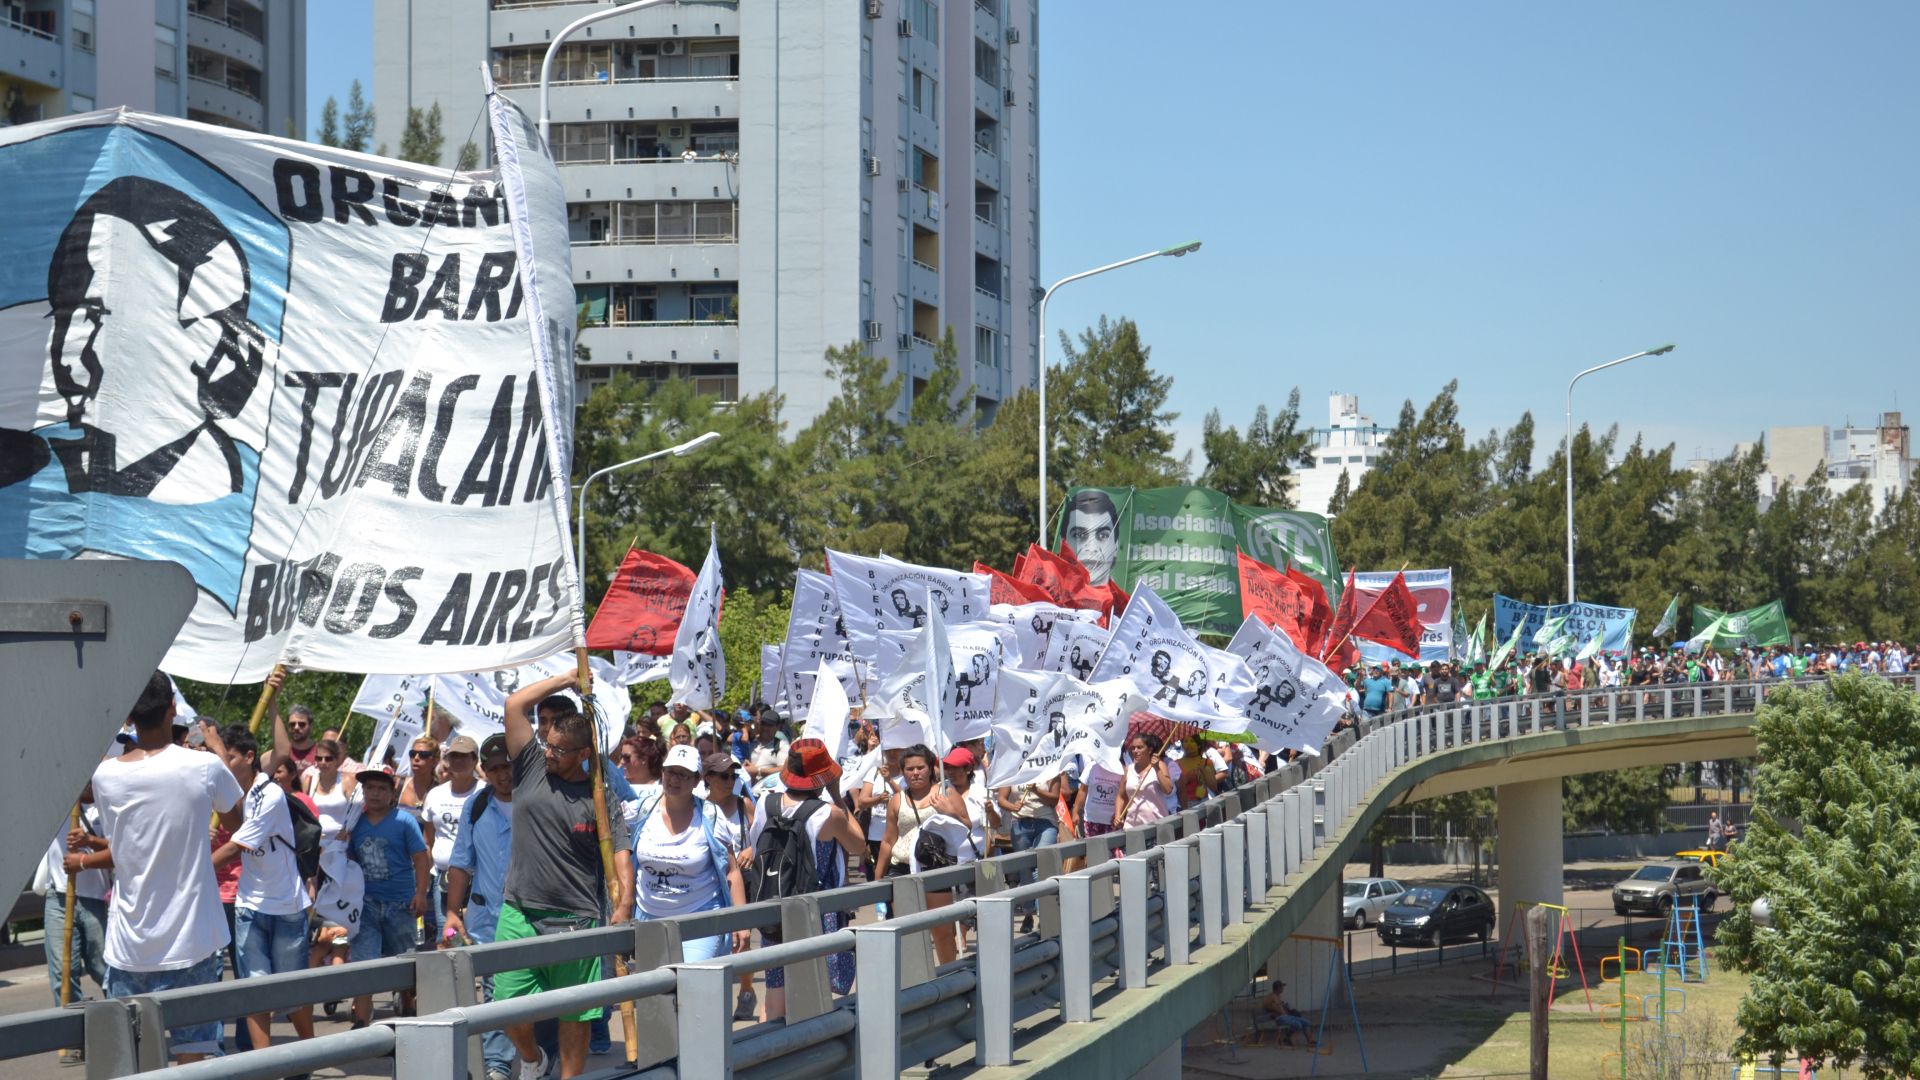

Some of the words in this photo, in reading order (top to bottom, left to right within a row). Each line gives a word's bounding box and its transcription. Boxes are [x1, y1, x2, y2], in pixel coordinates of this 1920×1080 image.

[1133, 512, 1236, 538] Asociación
[244, 551, 425, 644] BUENOS
[417, 553, 564, 647] AIRES
[868, 570, 885, 630] BUENO
[1122, 615, 1153, 675] BUENO
[1021, 688, 1038, 760] BUENO
